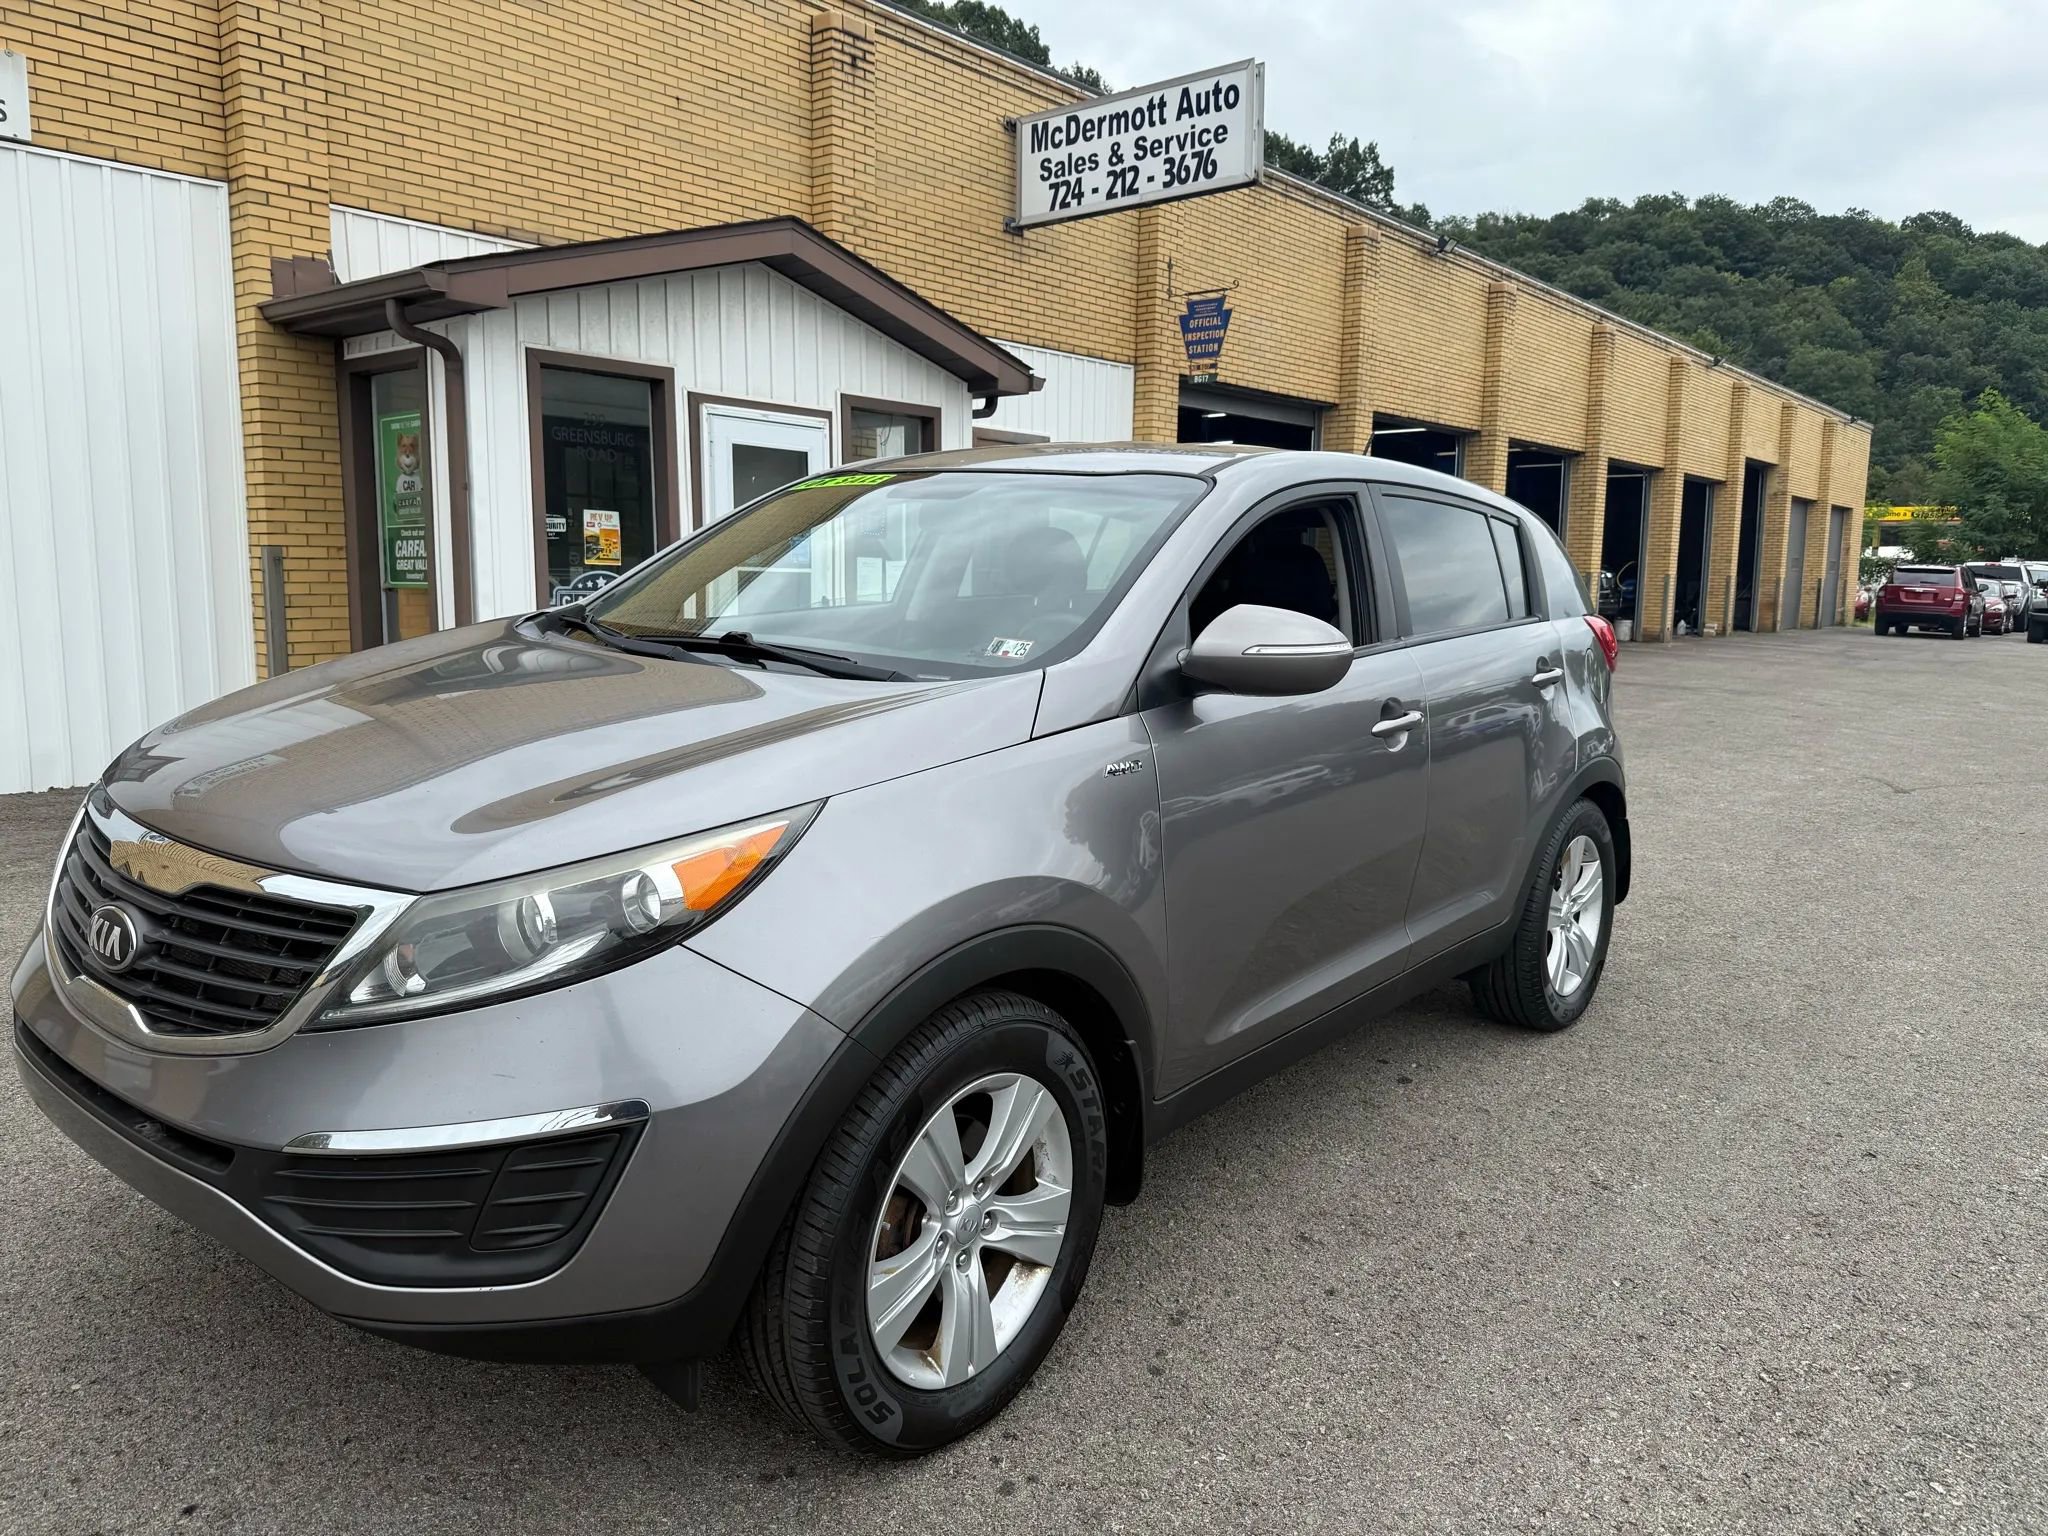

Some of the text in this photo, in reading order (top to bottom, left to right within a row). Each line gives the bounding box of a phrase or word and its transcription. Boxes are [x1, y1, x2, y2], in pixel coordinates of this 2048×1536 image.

[1031, 79, 1240, 154] McDermott Auto
[1039, 124, 1228, 182] Sales & Service
[1048, 177, 1084, 212] 724
[1105, 165, 1140, 201] 212
[1162, 148, 1217, 189] 3676
[1189, 317, 1222, 328] OFFICIAL
[1184, 329, 1225, 341] INSPECTION
[1188, 343, 1219, 354] STATION
[551, 425, 635, 447] GREENSBURG
[576, 446, 617, 463] ROAD
[402, 480, 415, 491] CAR
[395, 539, 427, 558] CARFA
[90, 914, 121, 961] KIA
